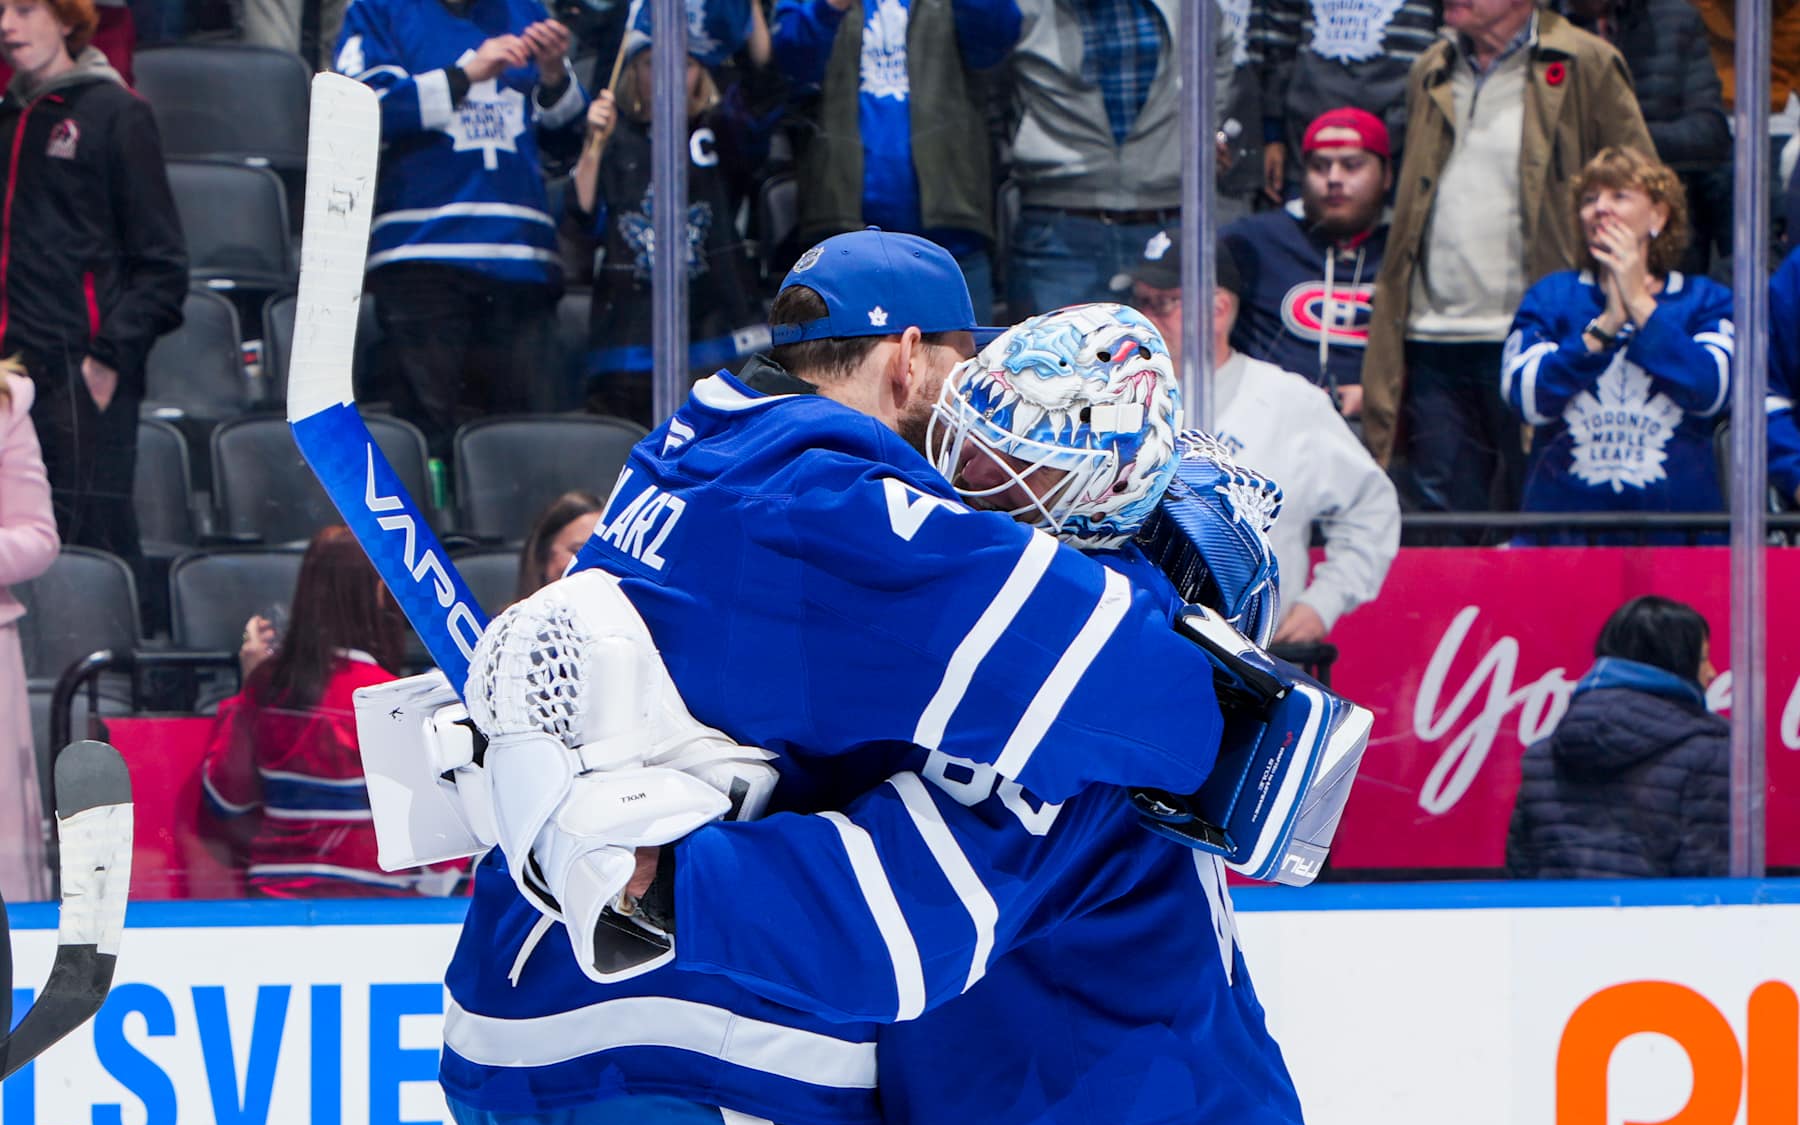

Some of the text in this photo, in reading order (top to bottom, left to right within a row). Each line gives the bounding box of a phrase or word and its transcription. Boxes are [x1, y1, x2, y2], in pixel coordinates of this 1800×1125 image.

[690, 128, 719, 167] C
[1581, 411, 1662, 436] TORONTO
[1592, 431, 1645, 447] MAPLE
[1590, 447, 1644, 462] LEAFS
[592, 464, 687, 571] LARZ
